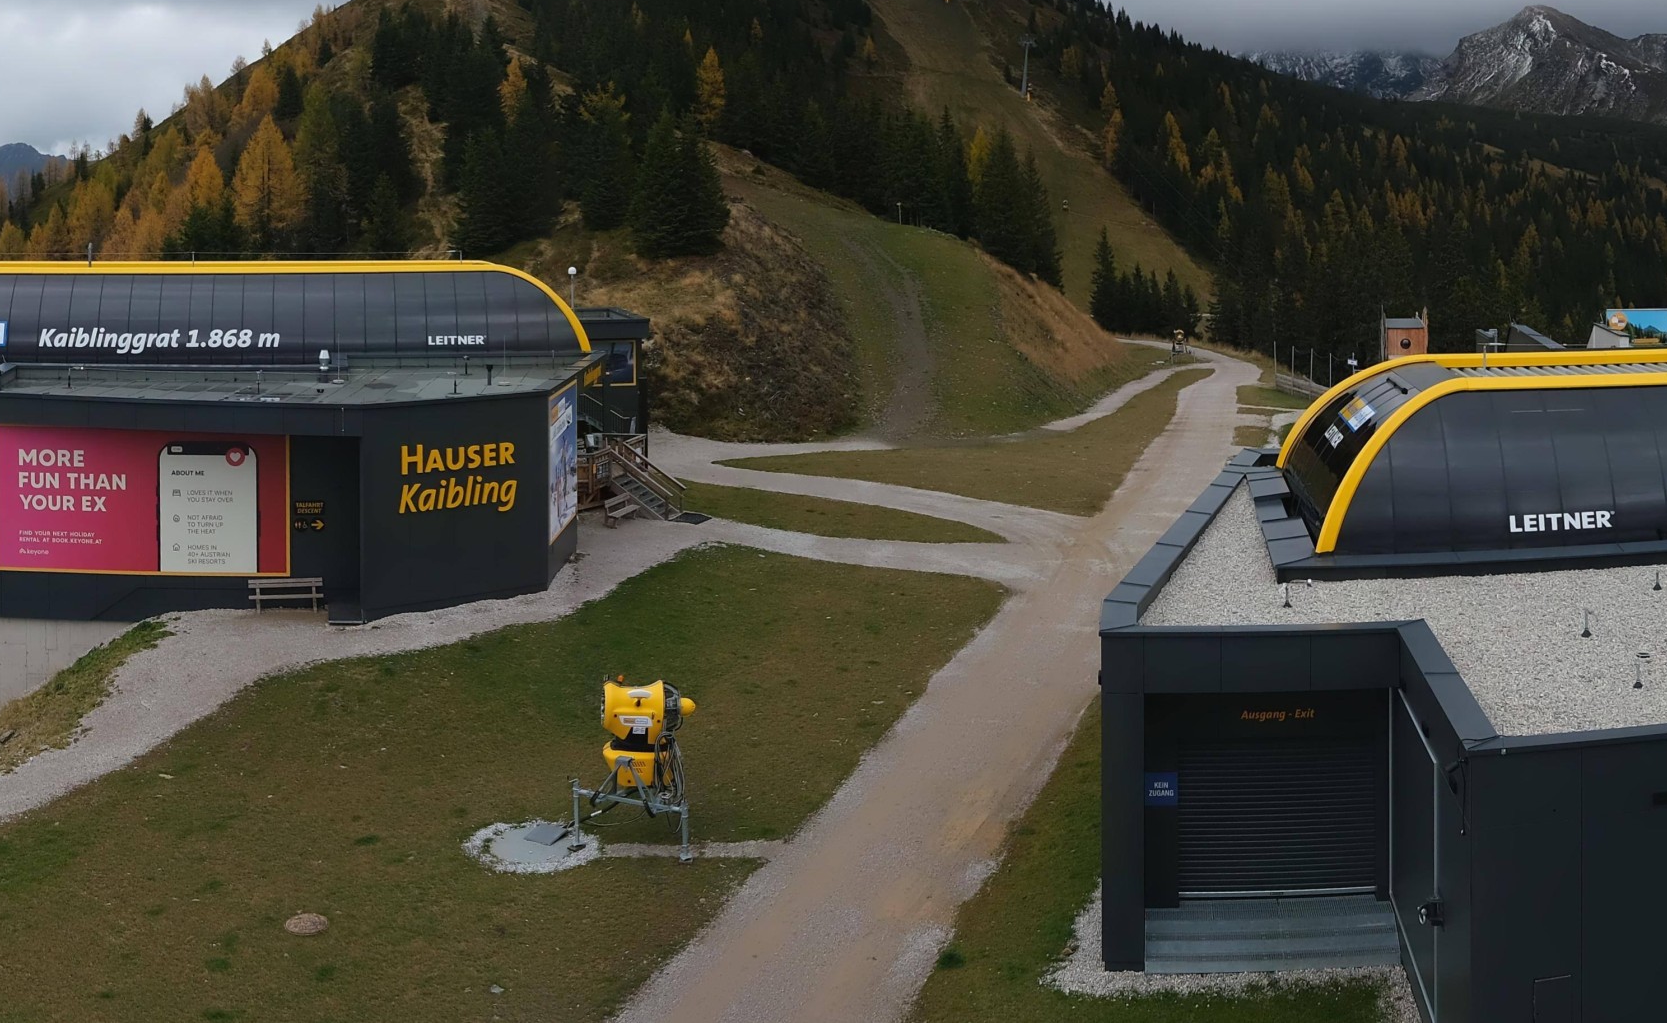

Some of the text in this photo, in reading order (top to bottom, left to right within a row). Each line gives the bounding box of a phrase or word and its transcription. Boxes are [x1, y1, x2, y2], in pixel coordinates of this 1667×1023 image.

[38, 327, 280, 354] Kaiblinggrat 1.868 m
[428, 335, 485, 346] LEITNER
[18, 448, 85, 467] MORE
[400, 442, 516, 475] HAUSER
[18, 471, 127, 490] FUN THAN
[20, 494, 107, 512] YOUR EX
[398, 475, 518, 514] Kaibling
[1509, 511, 1612, 533] LEITNER
[26, 548, 50, 556] keyone
[1240, 709, 1286, 722] Ausgang
[1295, 708, 1315, 719] Exit
